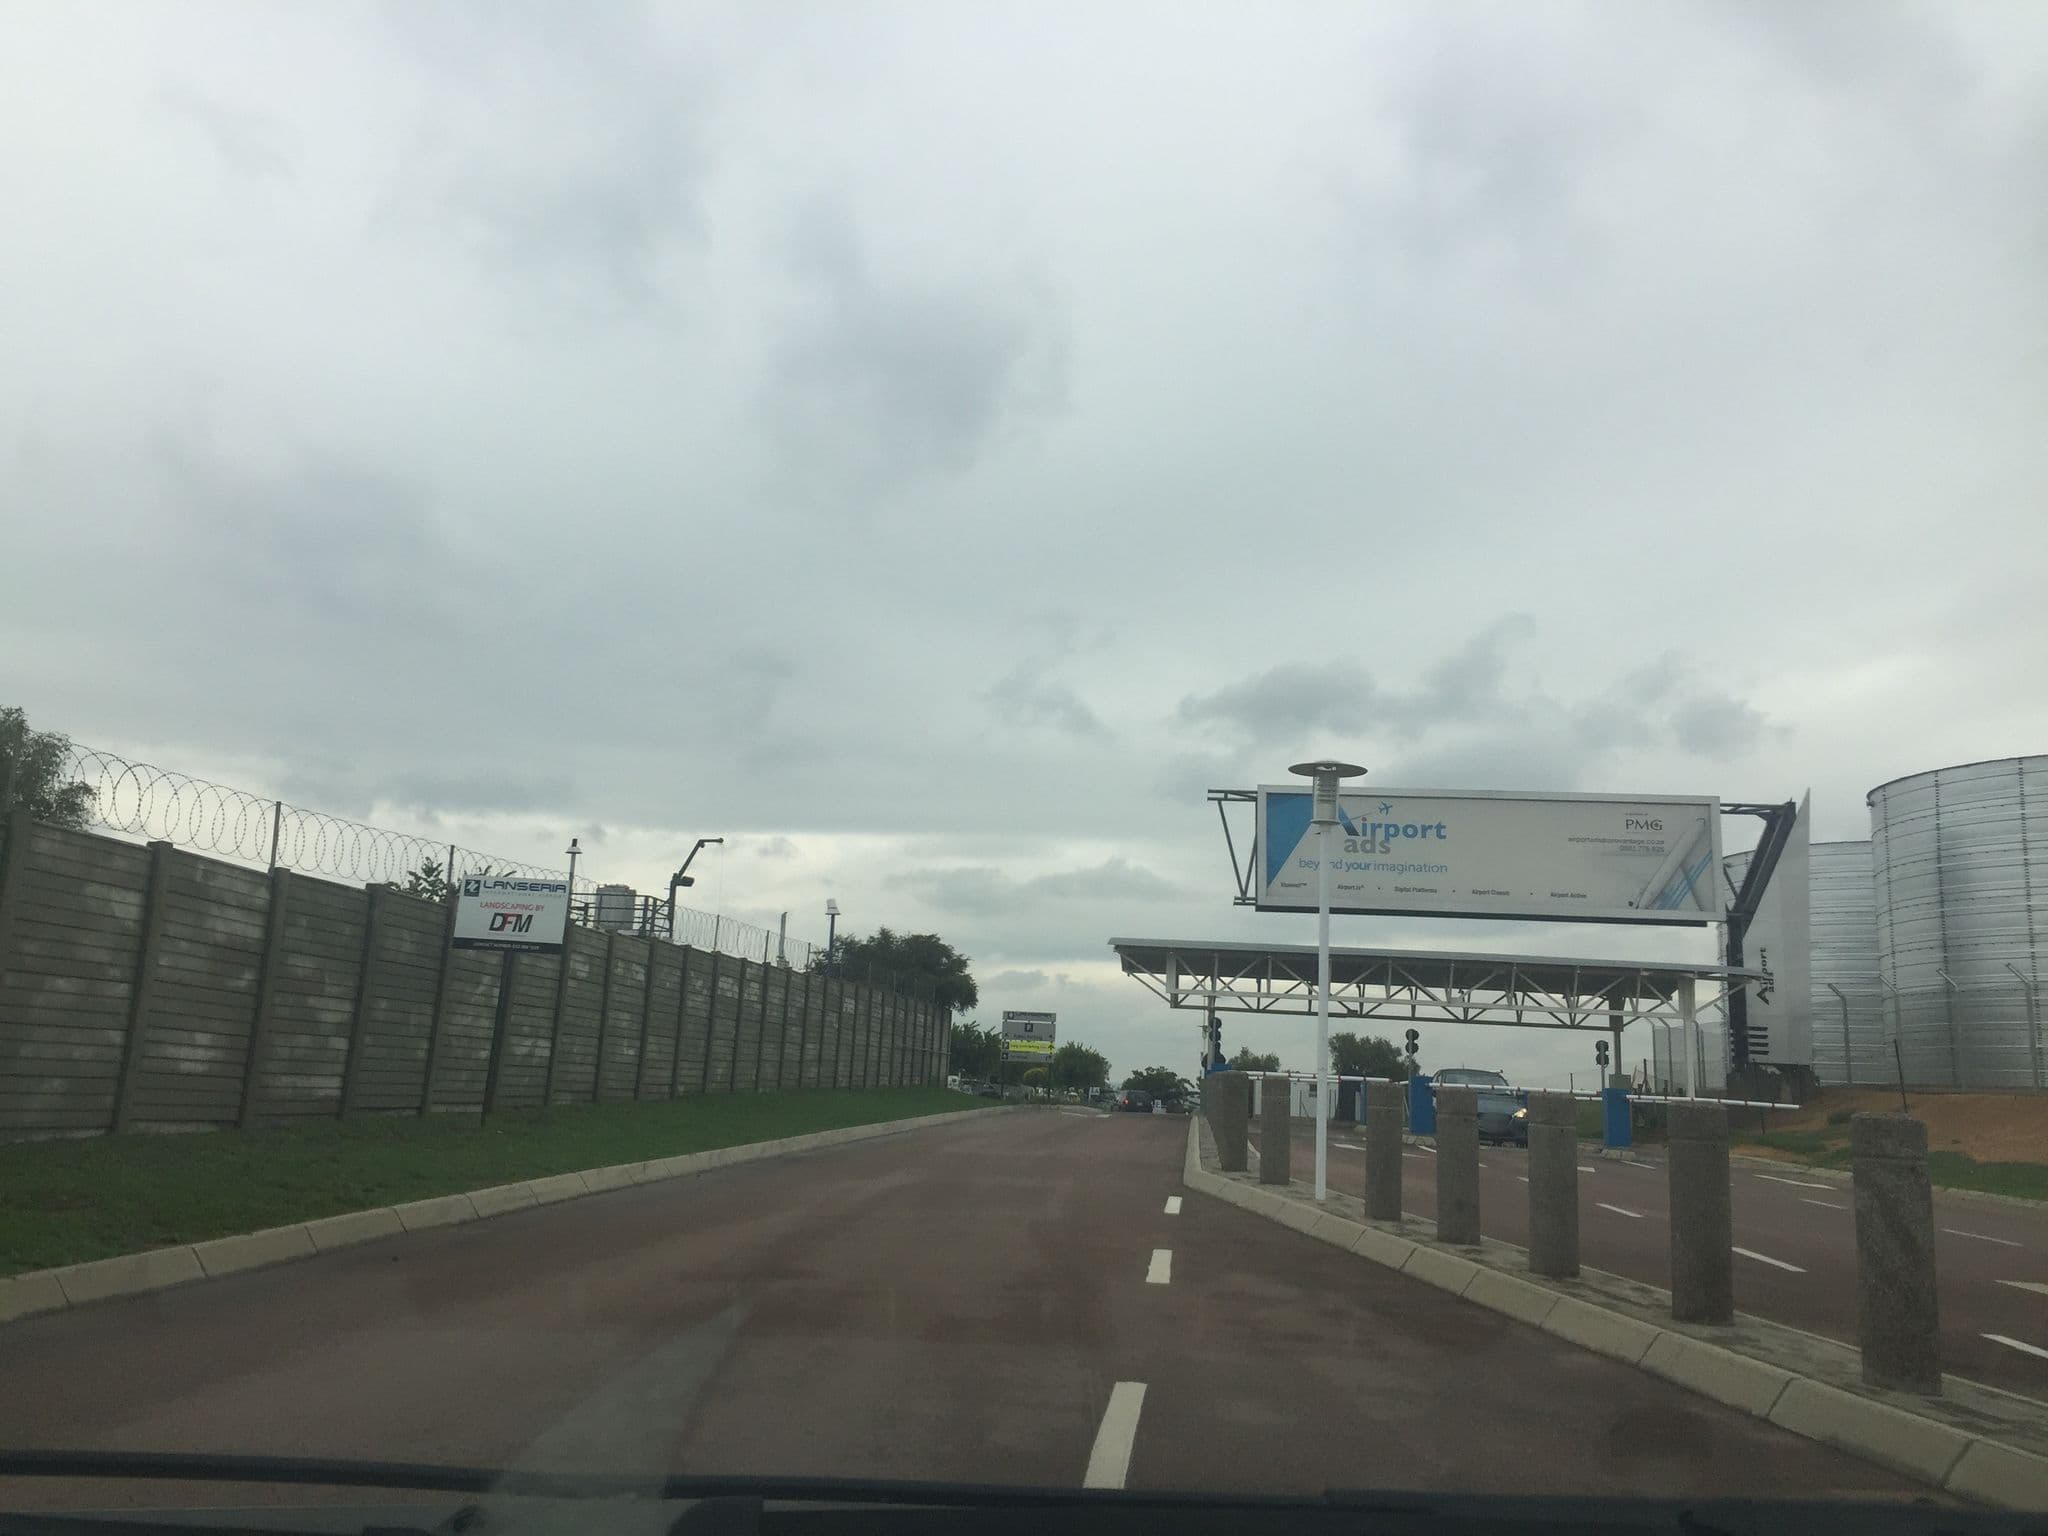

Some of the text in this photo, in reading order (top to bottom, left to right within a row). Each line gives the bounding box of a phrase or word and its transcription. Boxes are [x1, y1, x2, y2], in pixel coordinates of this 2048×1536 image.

[1625, 818, 1663, 831] PMG
[1343, 835, 1391, 855] ads
[1299, 857, 1448, 875] beynd your imagination
[483, 880, 567, 893] LANSERIA
[480, 901, 534, 911] LANDSCAPING
[489, 912, 534, 933] DFM
[1756, 947, 1769, 1005] Airport
